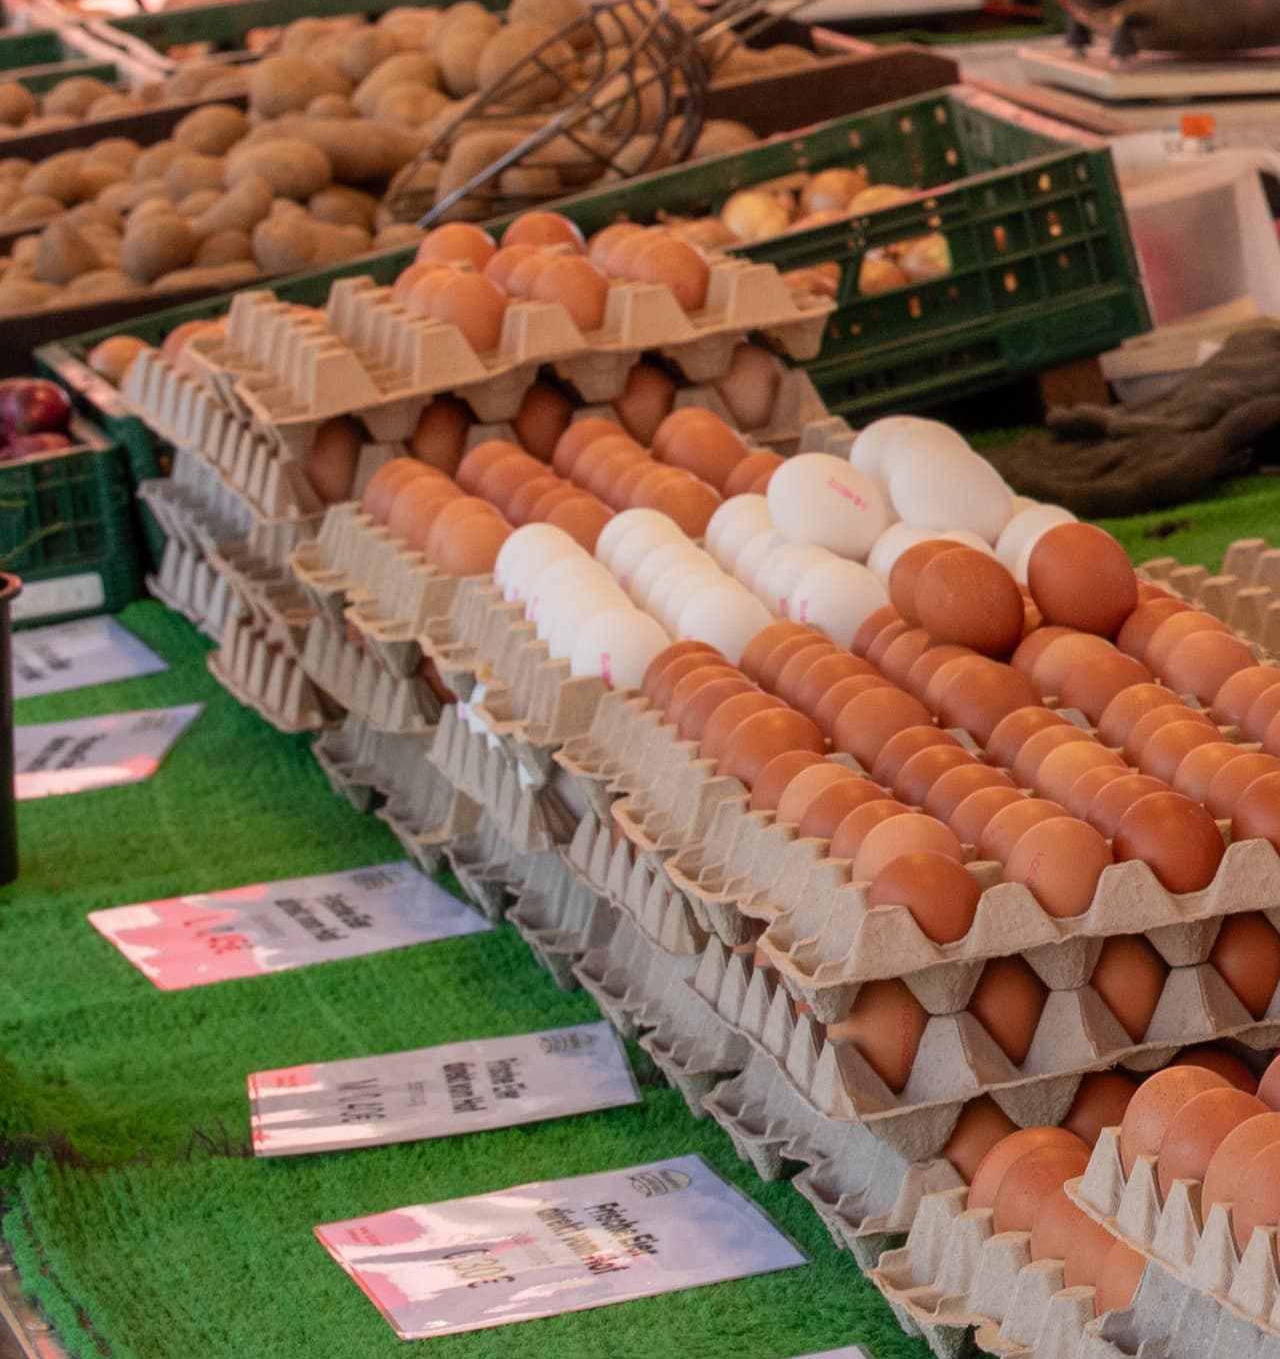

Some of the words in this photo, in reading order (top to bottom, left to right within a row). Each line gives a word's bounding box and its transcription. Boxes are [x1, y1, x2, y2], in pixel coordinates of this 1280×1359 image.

[535, 1208, 588, 1236] direkt
[583, 1201, 640, 1238] Frische
[617, 1233, 660, 1258] Eier
[559, 1235, 603, 1256] vom
